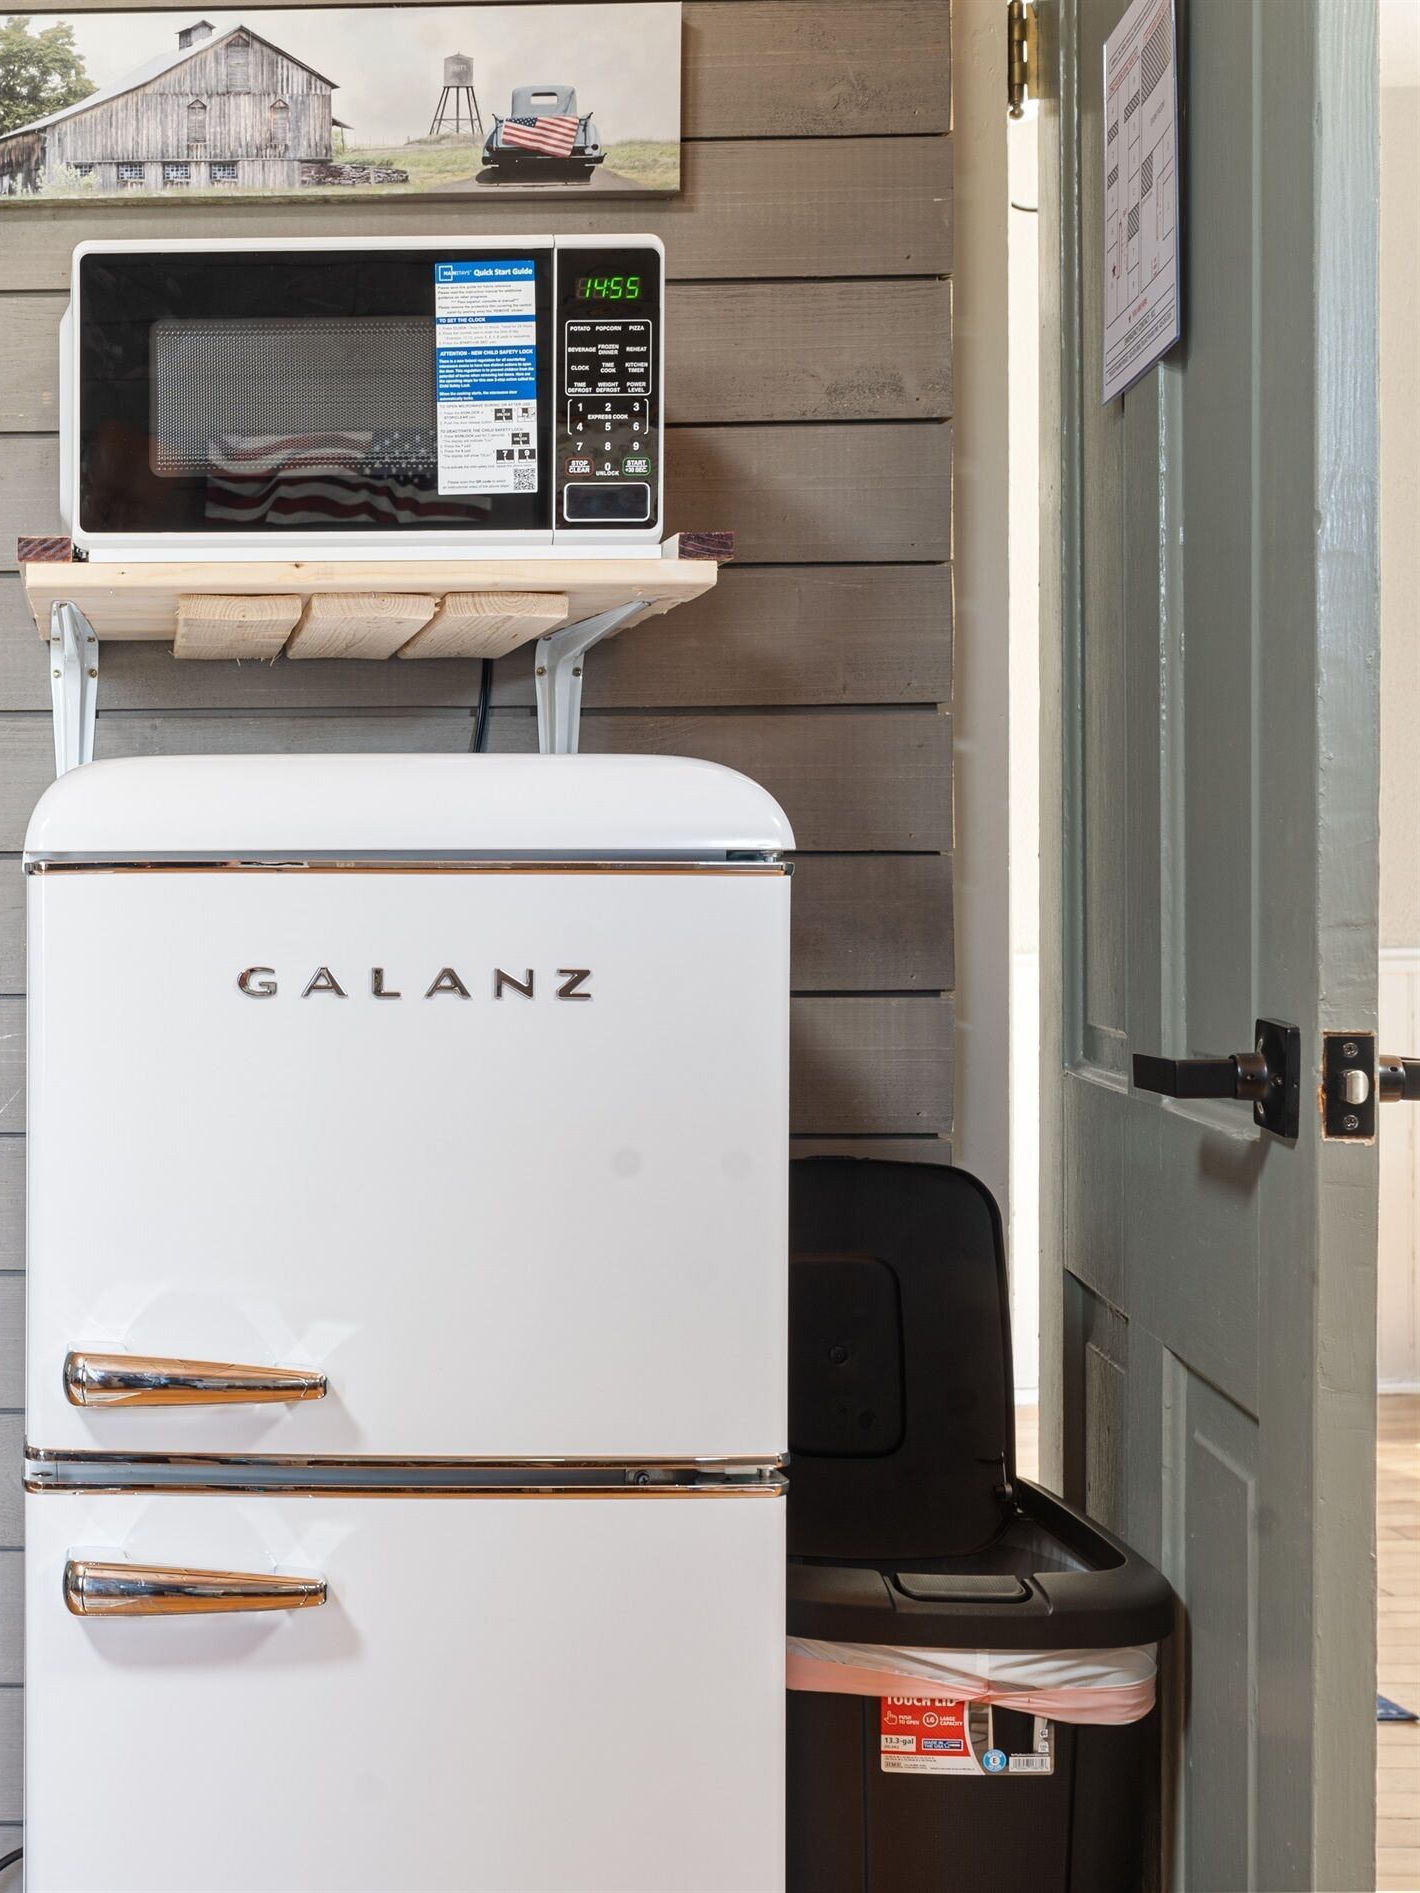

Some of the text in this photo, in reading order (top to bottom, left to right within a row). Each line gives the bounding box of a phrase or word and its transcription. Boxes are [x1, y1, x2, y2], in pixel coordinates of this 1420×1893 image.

[474, 268, 493, 277] Quick
[585, 277, 640, 299] 14:55
[578, 403, 583, 412] 1
[605, 403, 611, 412] 2
[633, 402, 640, 411] 3
[576, 423, 583, 431] 4
[605, 422, 611, 431] 5
[633, 422, 640, 431] 6
[576, 442, 583, 451] 7
[604, 442, 611, 451] 8
[633, 442, 640, 451] 9
[605, 462, 611, 471] 0
[236, 966, 592, 1000] GALANZ
